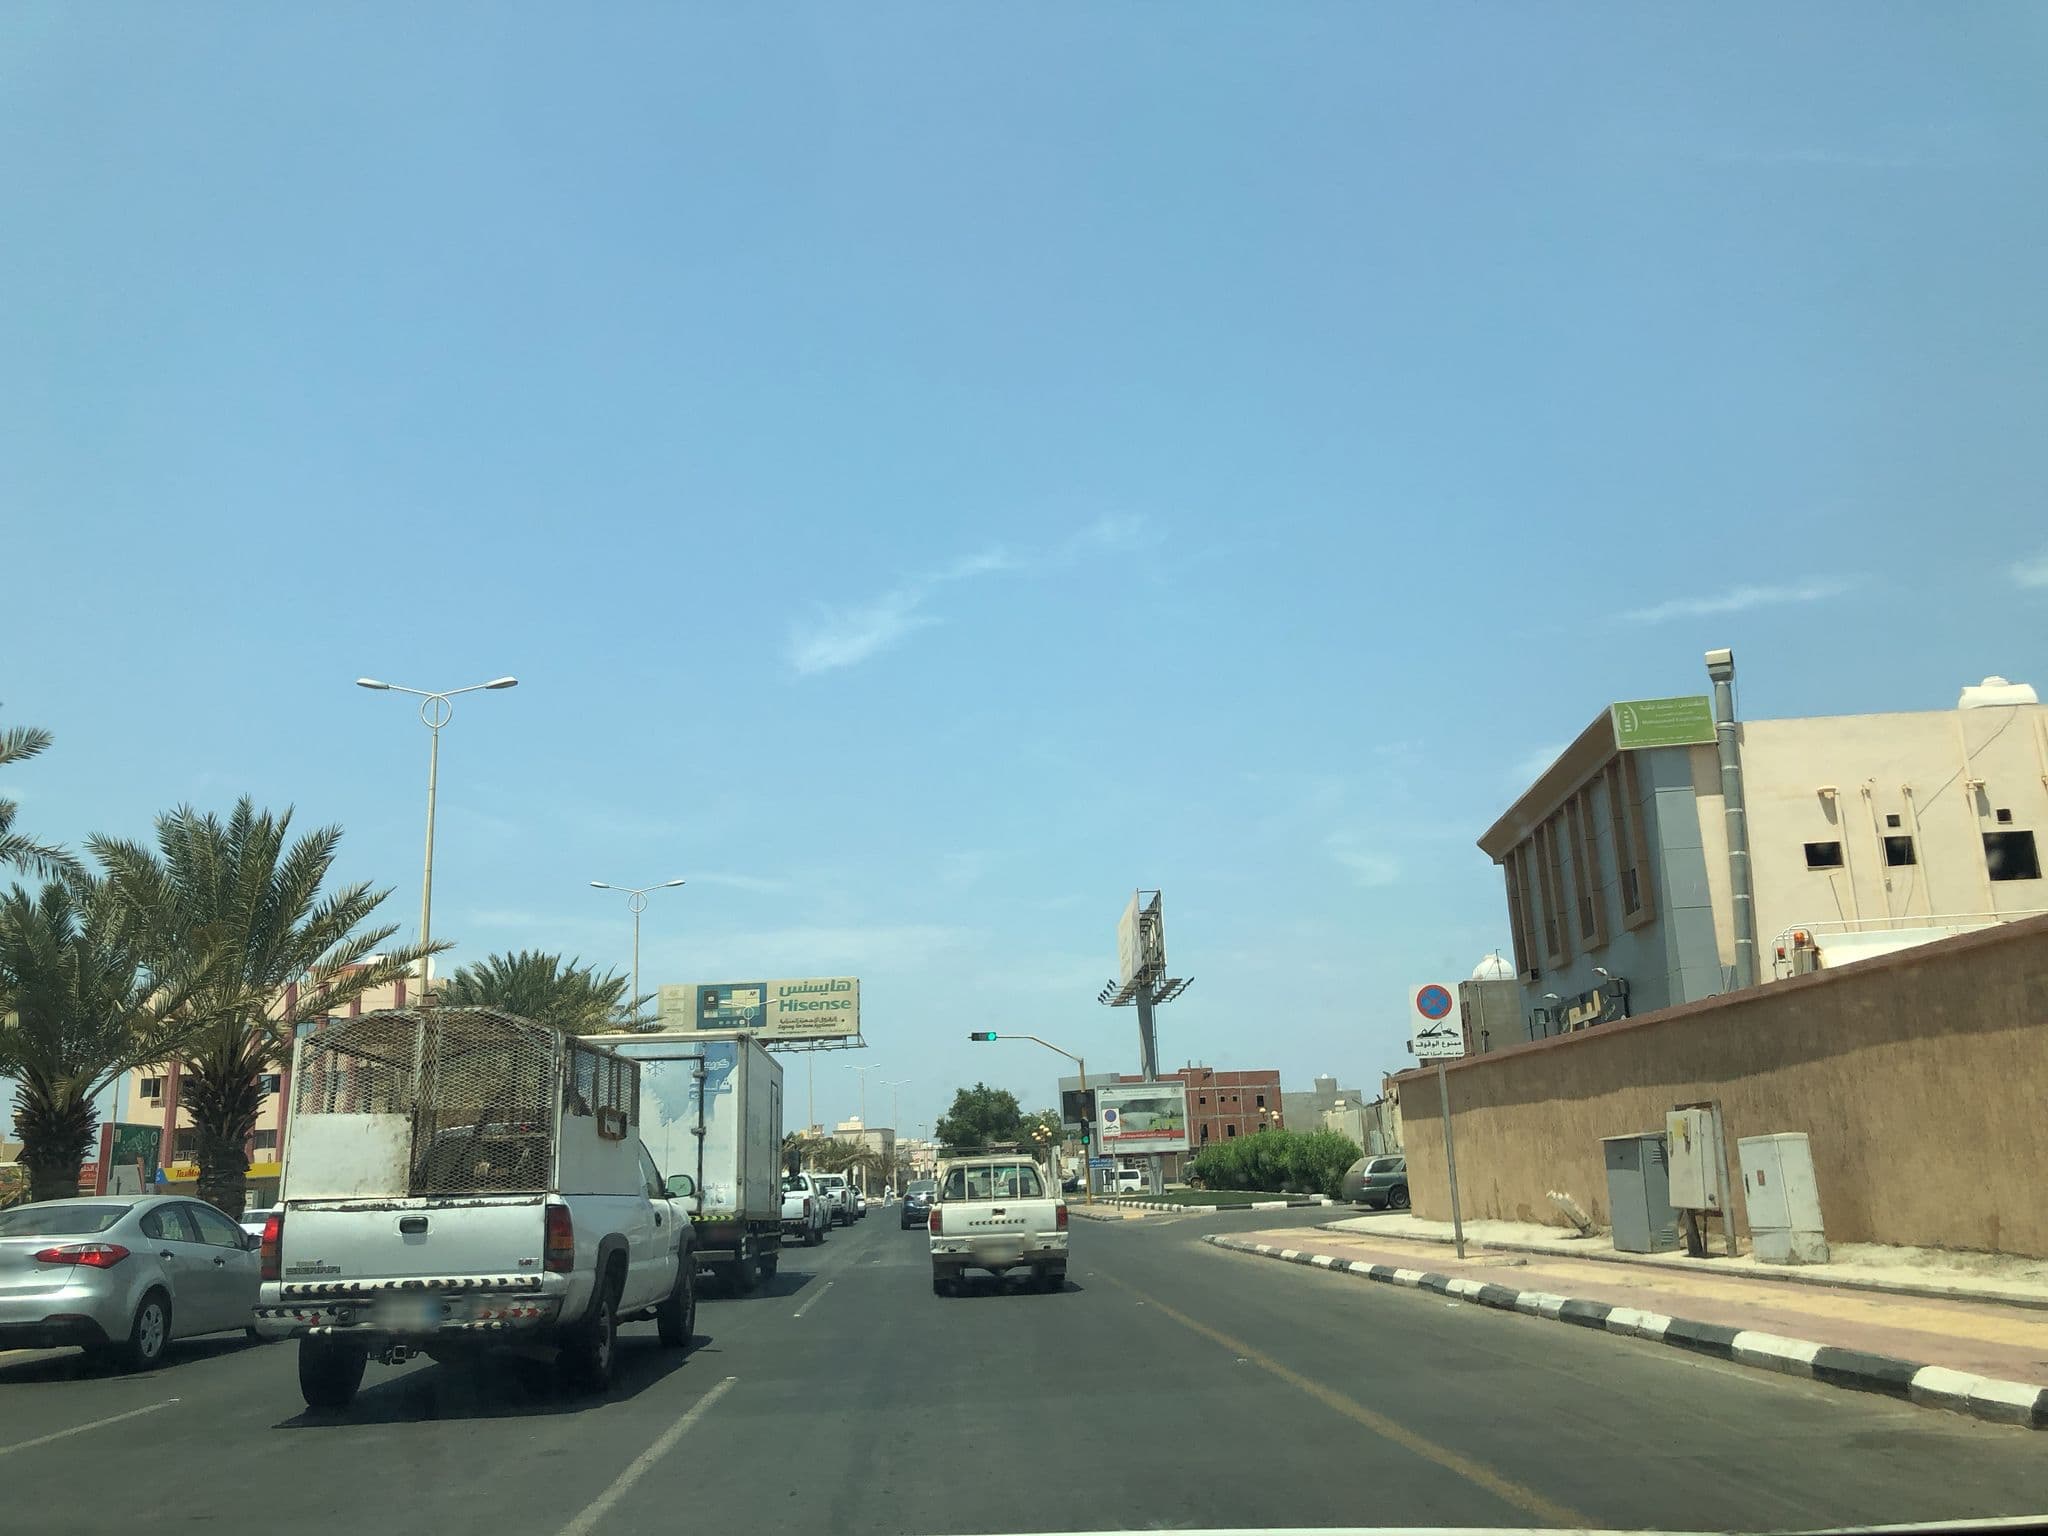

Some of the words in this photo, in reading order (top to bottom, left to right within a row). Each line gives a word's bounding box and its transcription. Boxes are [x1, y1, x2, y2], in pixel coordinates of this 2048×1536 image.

[779, 980, 852, 997] هايسنس
[779, 1000, 852, 1012] Hisense
[1415, 1040, 1440, 1048] الوقوف
